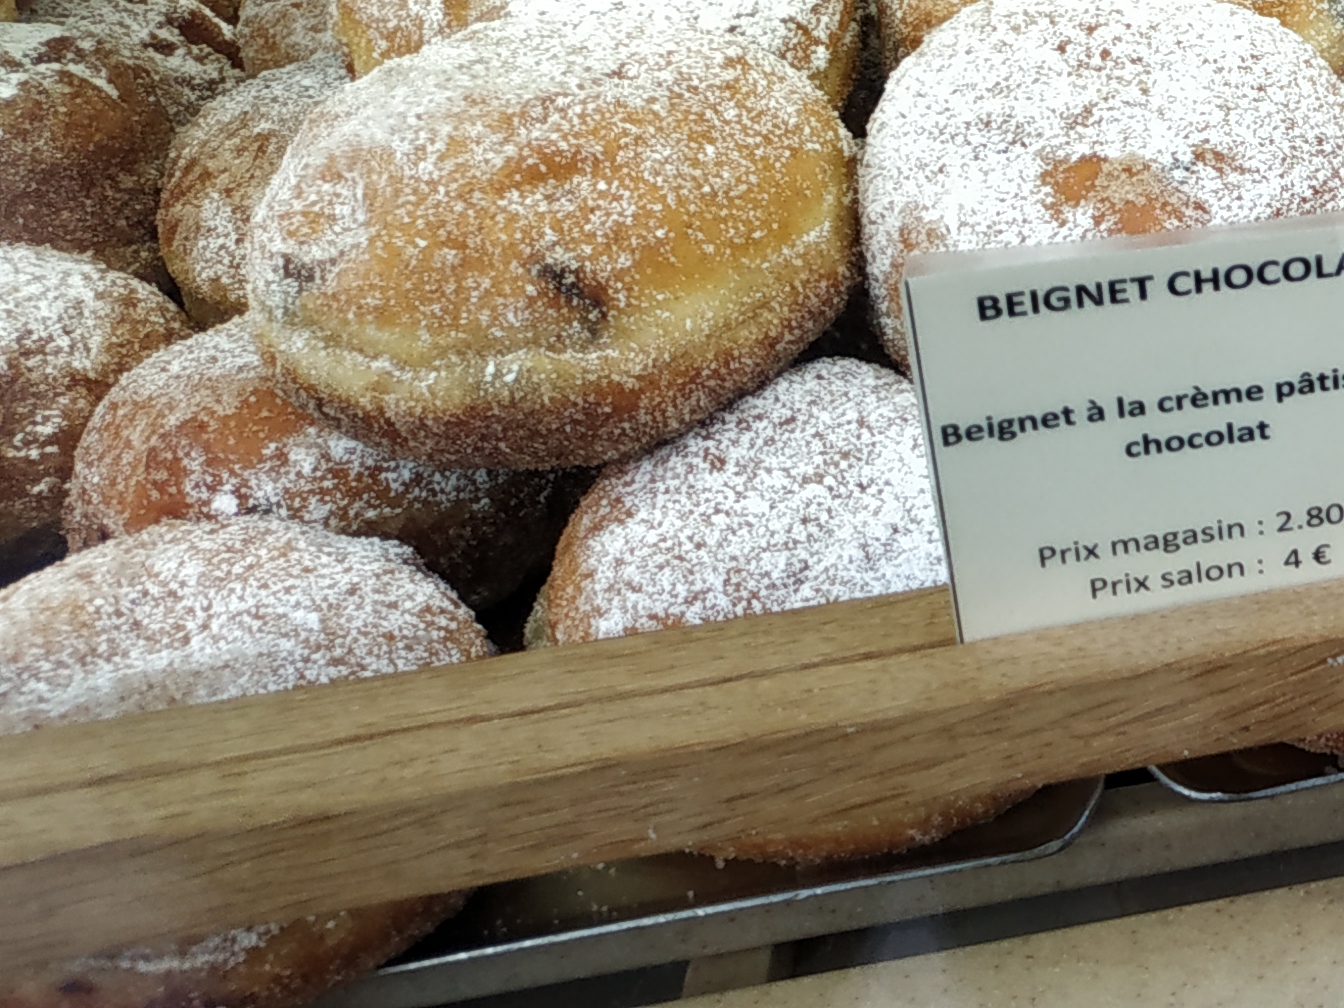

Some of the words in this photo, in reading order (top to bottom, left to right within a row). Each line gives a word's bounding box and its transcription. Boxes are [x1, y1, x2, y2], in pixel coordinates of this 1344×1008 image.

[977, 275, 1155, 321] BEIGNET
[941, 404, 1077, 447] Beignet
[1086, 400, 1106, 423] à
[1117, 396, 1146, 419] la
[1157, 380, 1265, 413] crème
[1125, 420, 1271, 458] chocolat
[1038, 540, 1101, 568] Prix
[1111, 519, 1246, 557] magasin
[1276, 501, 1344, 534] 2.80
[1090, 575, 1150, 599] Prix
[1161, 559, 1245, 589] salon
[1283, 549, 1302, 570] 4
[1312, 544, 1332, 565] €
